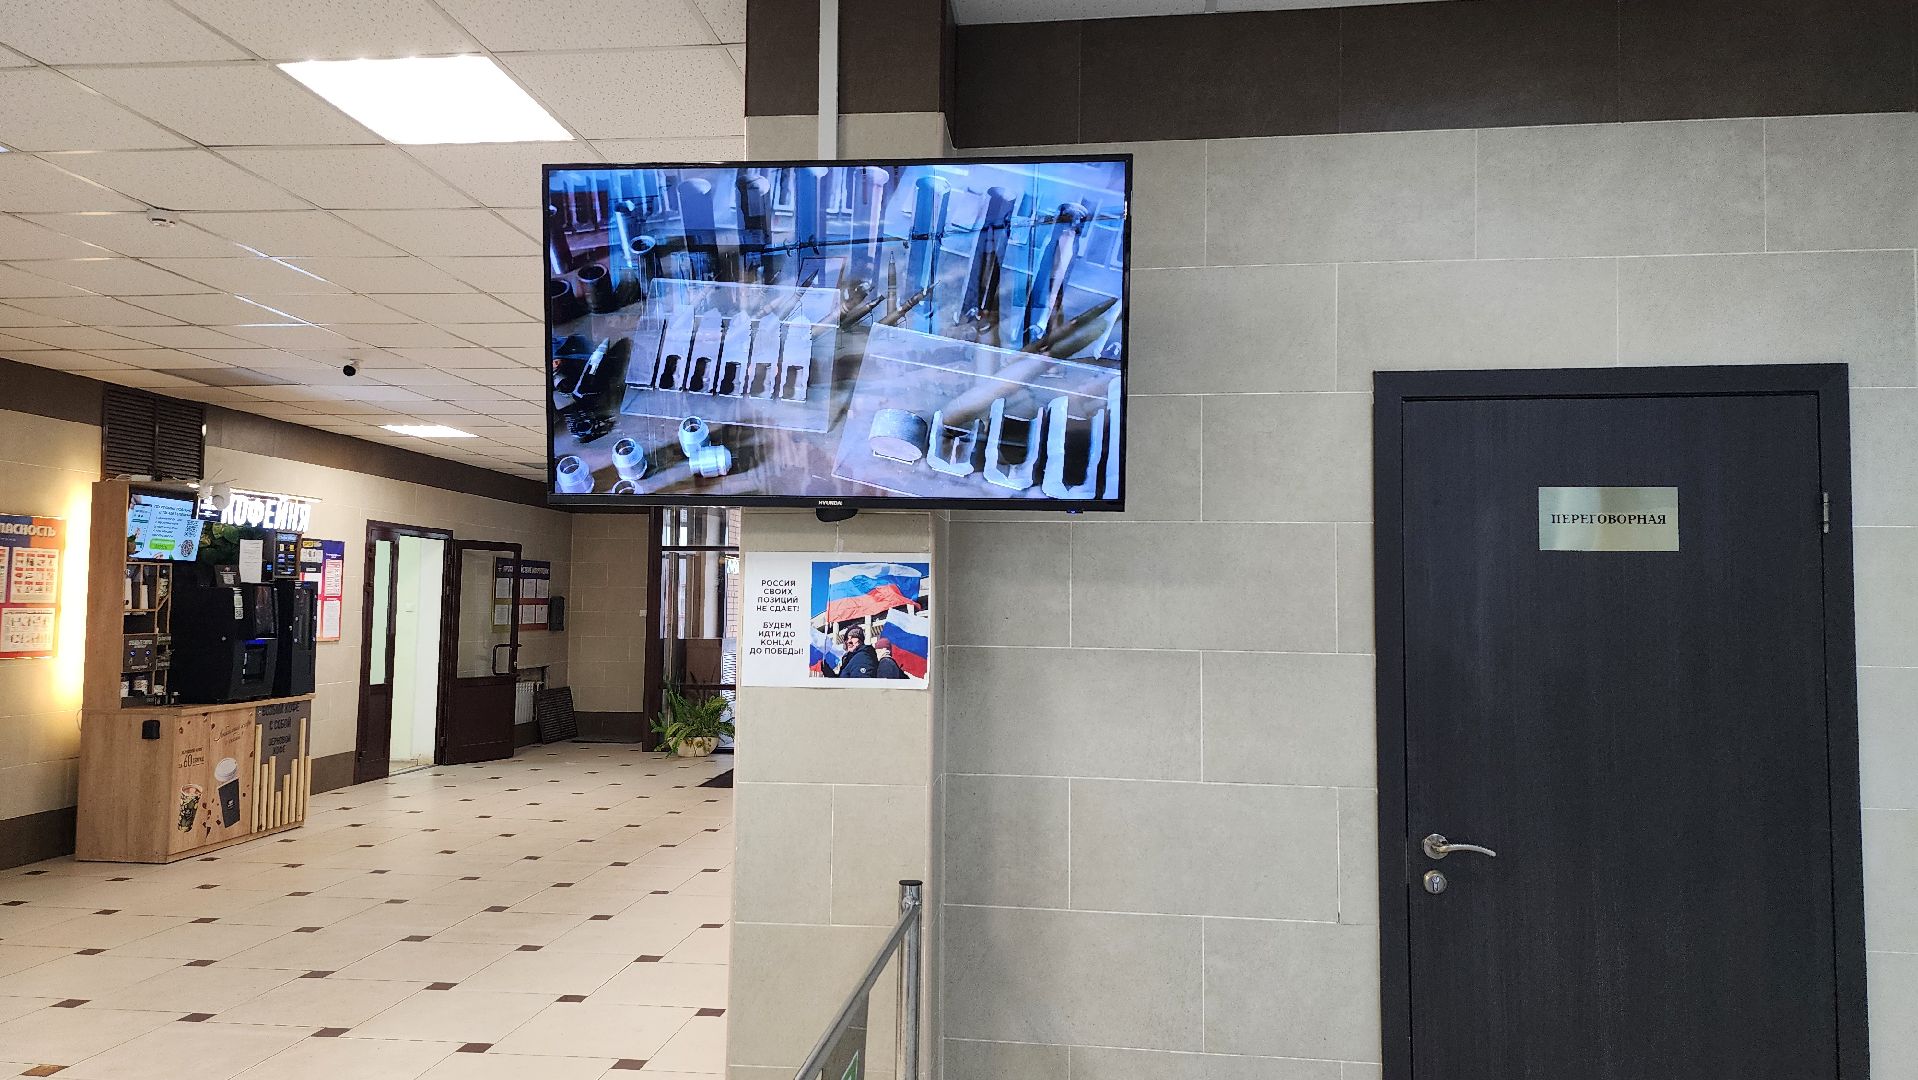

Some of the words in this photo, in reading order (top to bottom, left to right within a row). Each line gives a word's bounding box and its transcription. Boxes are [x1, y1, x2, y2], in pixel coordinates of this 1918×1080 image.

[1551, 514, 1667, 525] ПЕРЕГОВОРНАЯ
[761, 579, 796, 587] РОССИЯ
[757, 596, 799, 604] ПОЗИЦИЙ
[769, 605, 800, 613] СДАЕТ!
[763, 621, 792, 630] БУДЕМ
[758, 630, 782, 638] ИДТИ
[782, 631, 796, 639] ДО
[760, 639, 793, 647] КОНЦА!
[749, 647, 762, 655] ДО
[764, 647, 804, 656] ПОБЕДЫ!
[183, 754, 193, 768] 60
